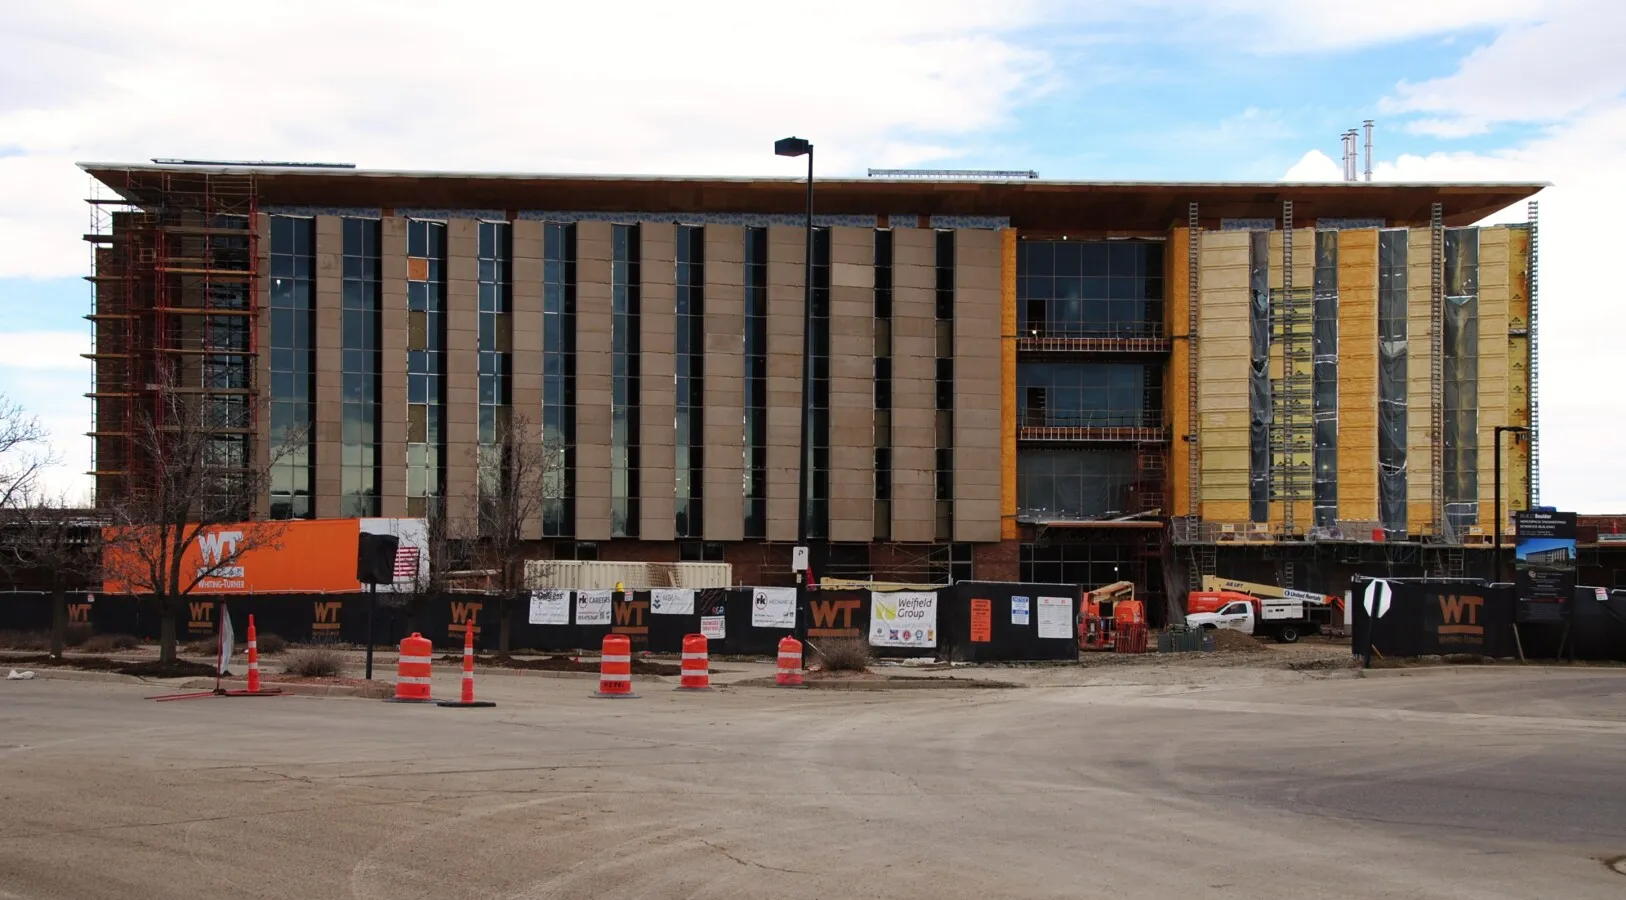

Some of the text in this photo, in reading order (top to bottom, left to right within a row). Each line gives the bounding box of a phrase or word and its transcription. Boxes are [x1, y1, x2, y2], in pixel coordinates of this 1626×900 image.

[198, 531, 243, 565] WT
[579, 595, 587, 604] rk
[756, 595, 766, 605] rk
[898, 597, 933, 609] Weifield
[1305, 593, 1321, 601] Rentals
[68, 604, 92, 621] WT
[189, 602, 214, 621] WT
[314, 602, 342, 622] WT
[450, 602, 483, 624] WT
[613, 601, 649, 626] WT
[809, 600, 861, 628] WT
[898, 608, 925, 620] Group
[1438, 595, 1484, 624] WT
